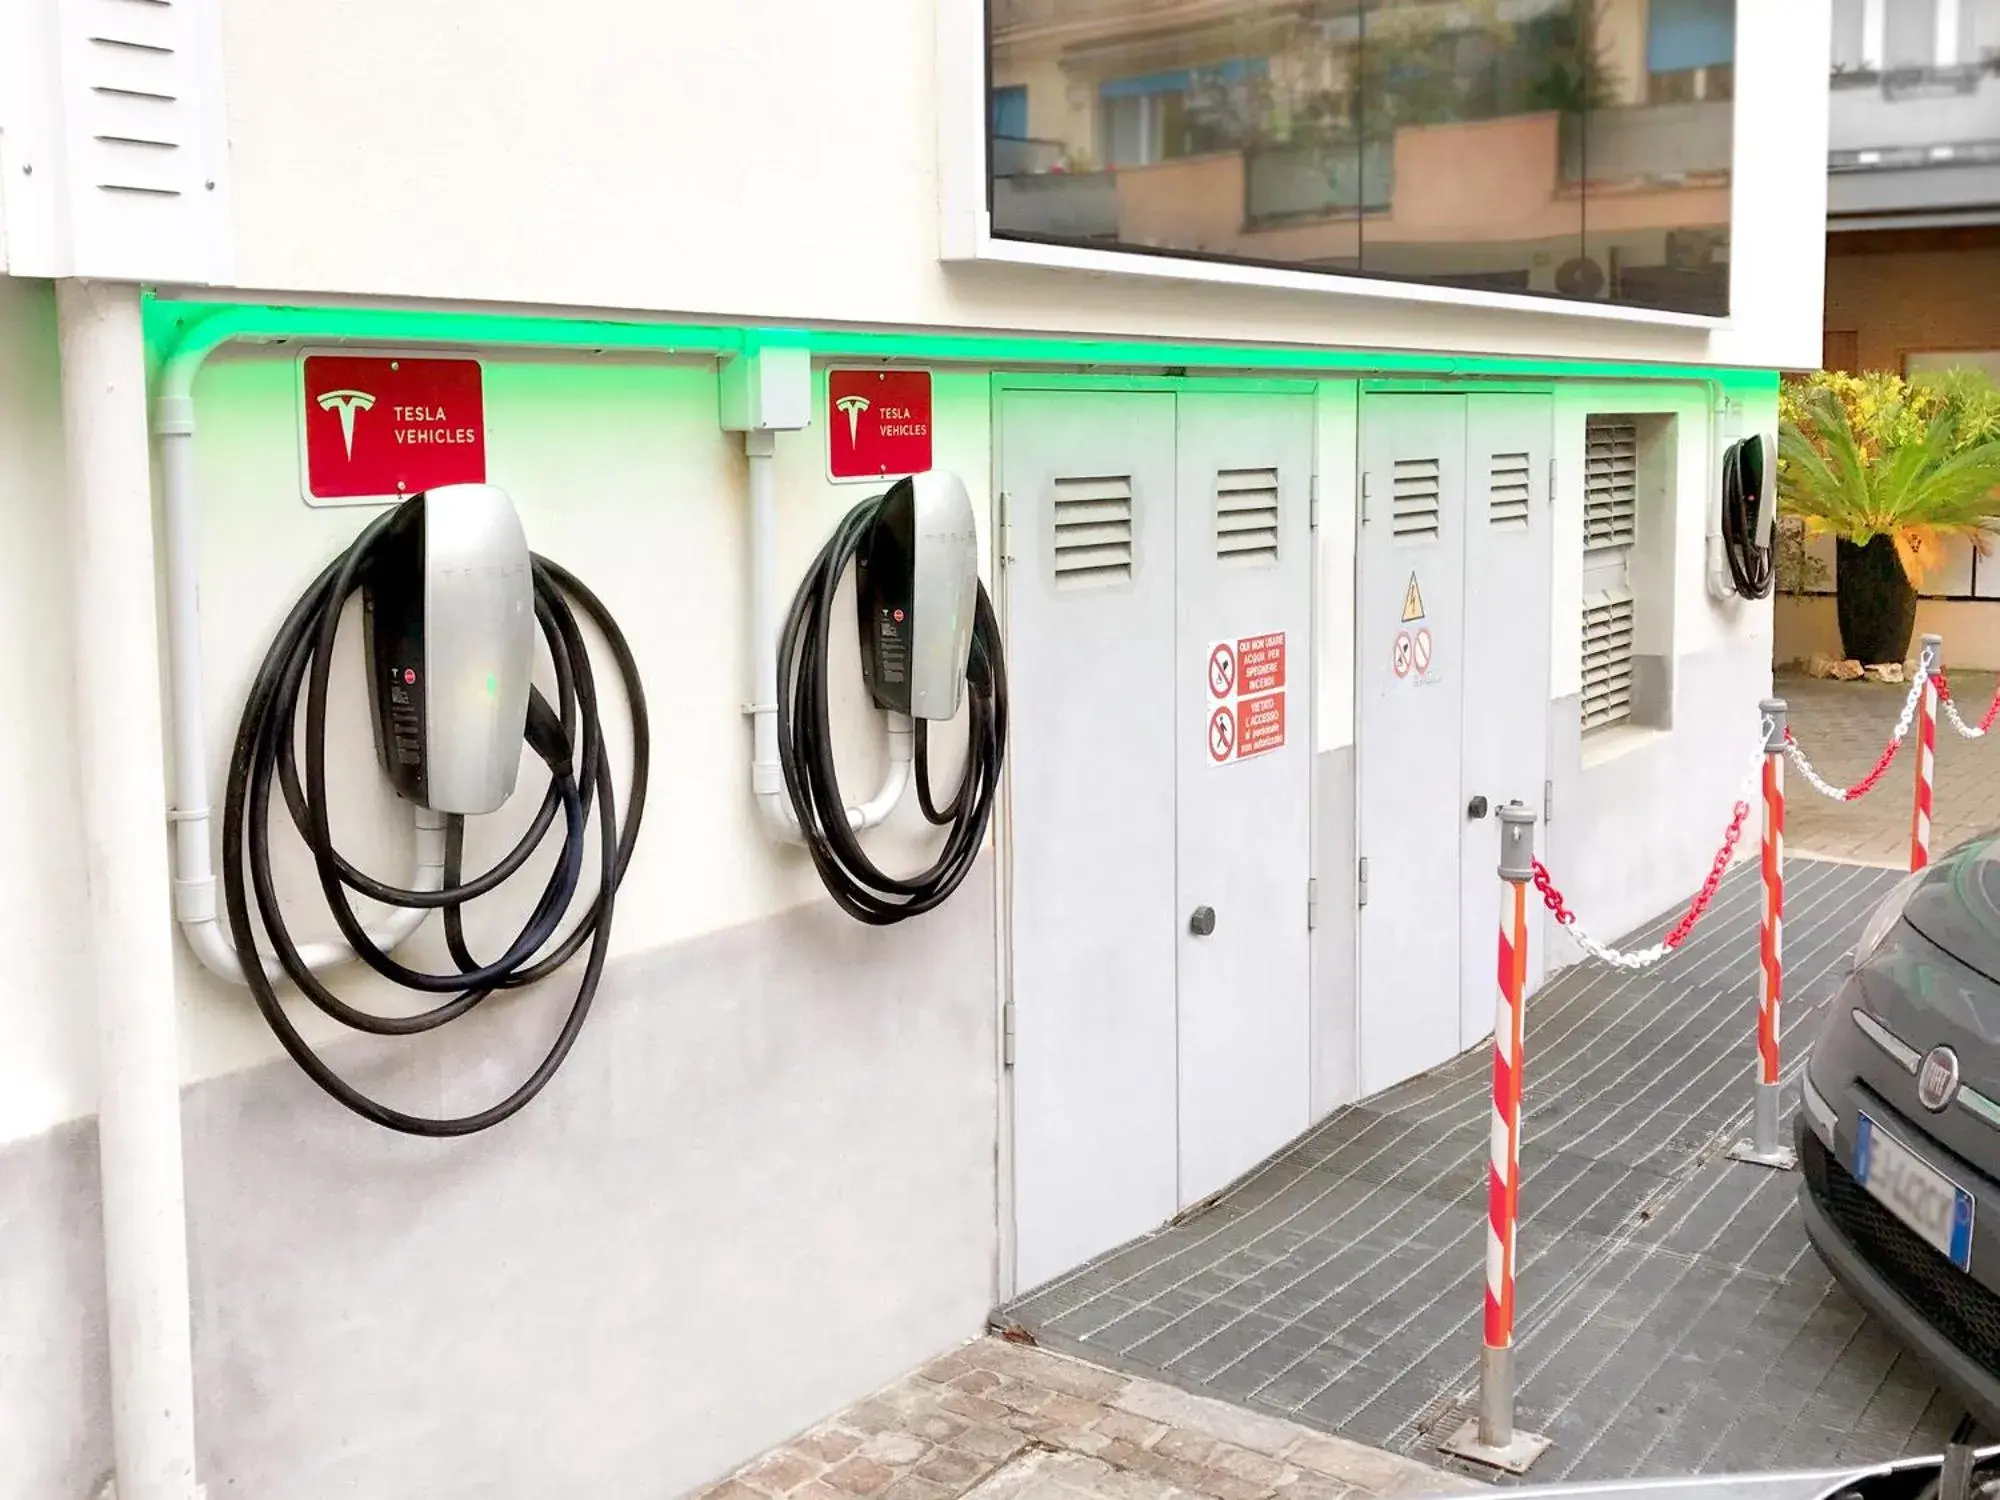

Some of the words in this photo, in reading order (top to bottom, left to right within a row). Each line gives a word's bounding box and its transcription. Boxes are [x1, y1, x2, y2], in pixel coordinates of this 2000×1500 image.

[393, 406, 446, 421] TESLA
[880, 407, 911, 420] TESLA
[394, 429, 475, 444] VEHICLES
[880, 424, 927, 437] VEHICLES
[1251, 638, 1265, 650] NON
[1243, 651, 1265, 665] ACQUA
[1267, 648, 1280, 659] PER
